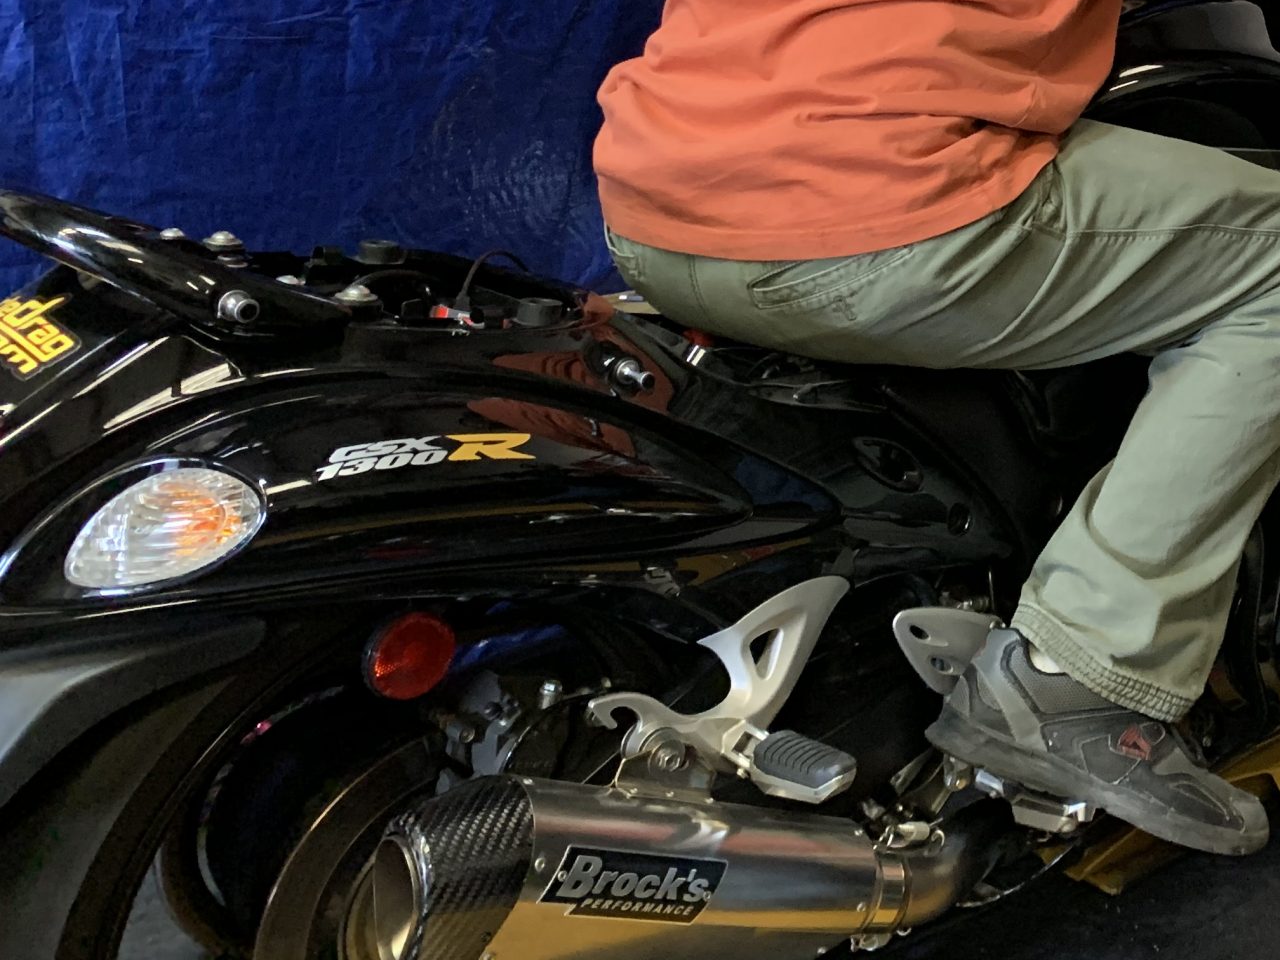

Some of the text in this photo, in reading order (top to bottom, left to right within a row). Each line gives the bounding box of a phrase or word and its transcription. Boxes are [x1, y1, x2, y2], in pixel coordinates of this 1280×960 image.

[316, 450, 448, 482] 1300
[555, 854, 710, 903] Brock's
[580, 898, 695, 916] PERFORMANCE
